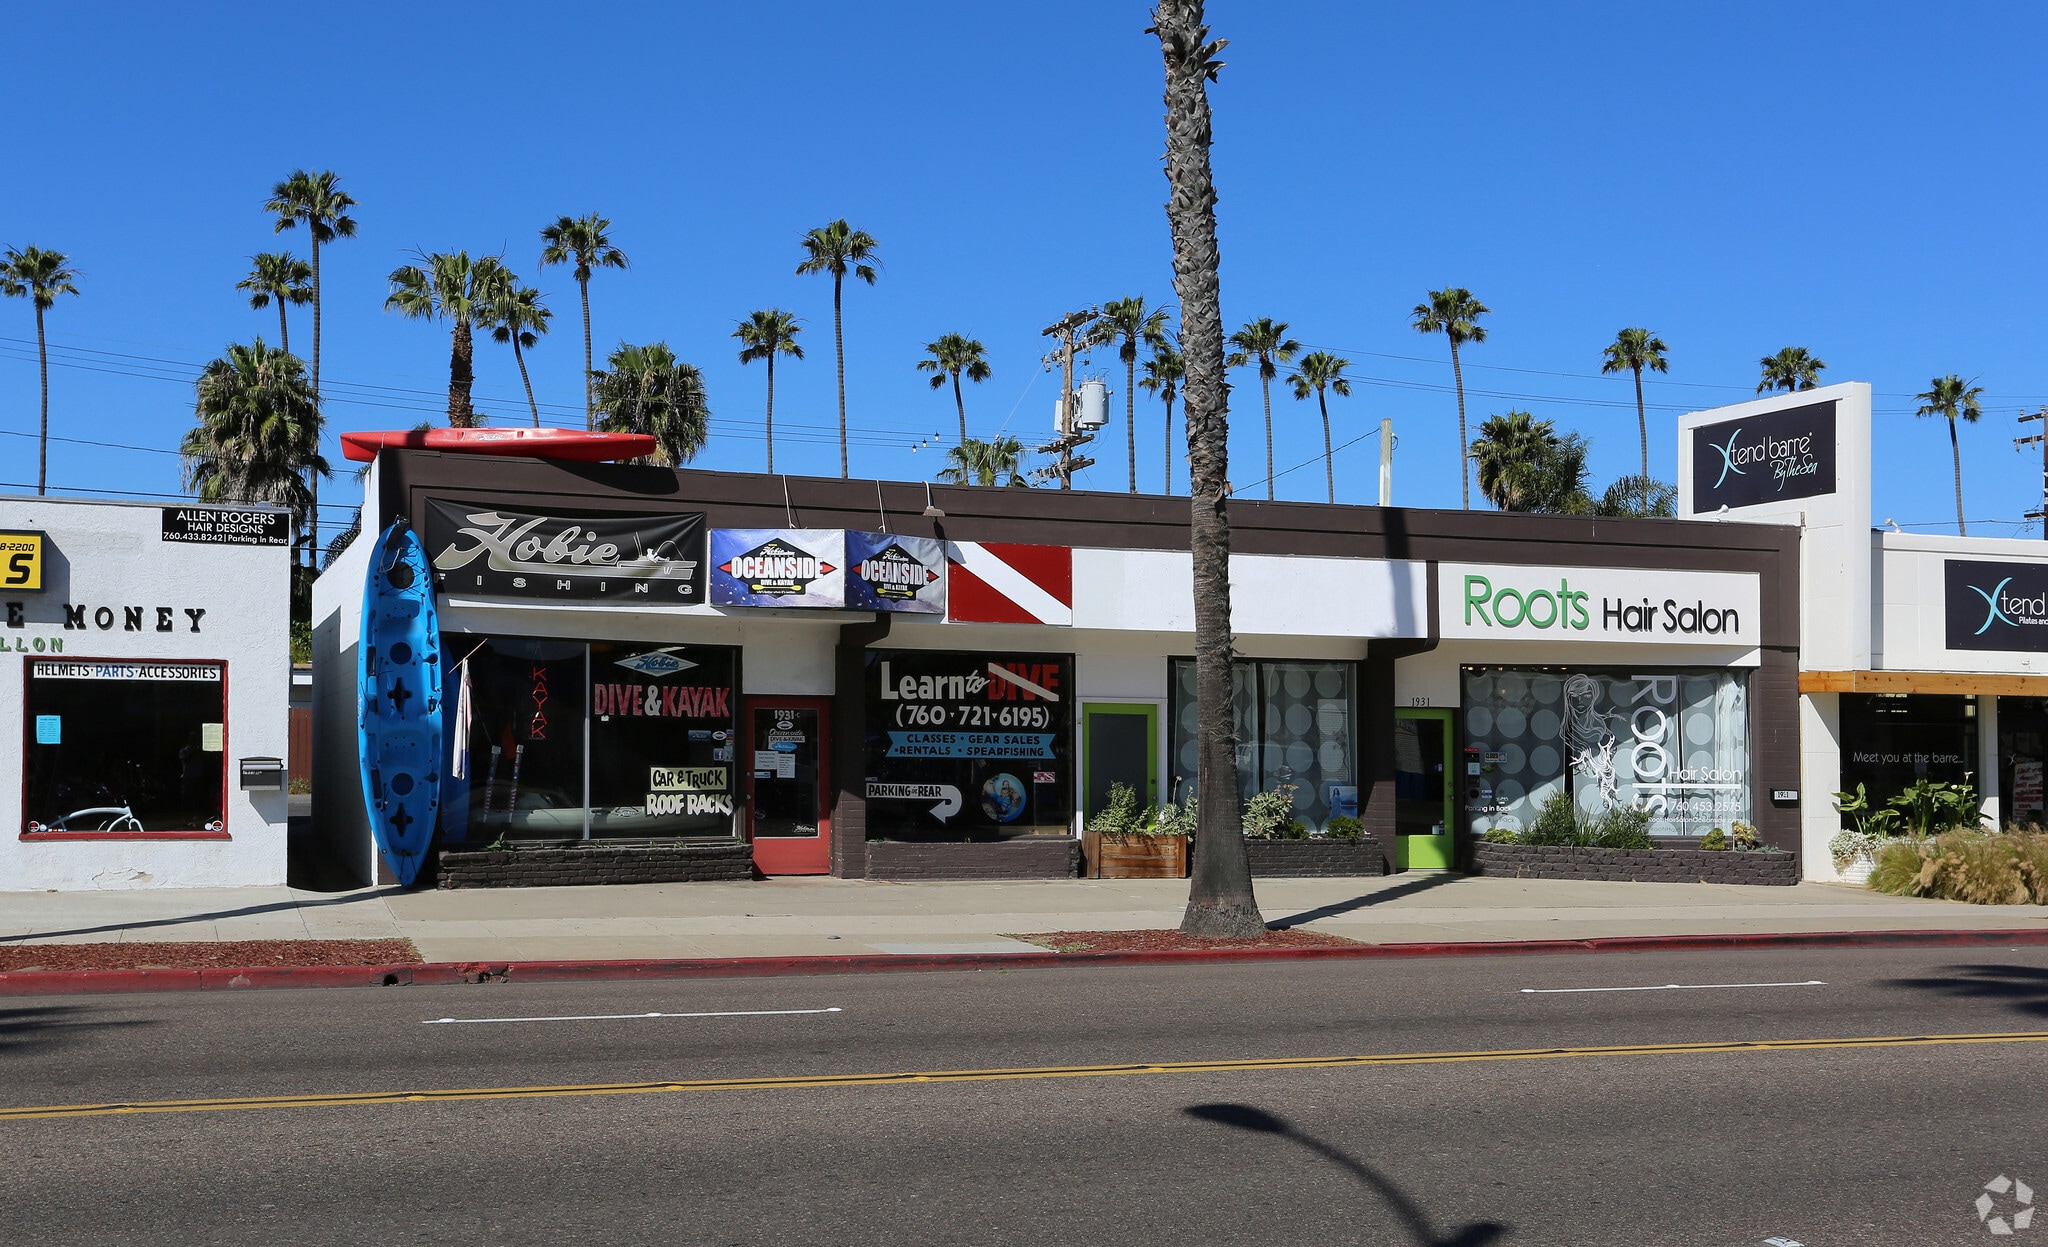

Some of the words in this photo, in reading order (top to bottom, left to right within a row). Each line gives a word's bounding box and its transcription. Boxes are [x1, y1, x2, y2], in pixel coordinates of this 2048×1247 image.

[176, 510, 217, 522] ALLEN
[221, 511, 275, 525] ROGERS
[187, 522, 213, 532] HAIR
[216, 523, 264, 534] DESIGNS
[227, 534, 258, 544] Parking
[731, 556, 824, 579] OCEANSIDE
[861, 559, 929, 585] OCEANSIDE
[1464, 575, 1589, 629] Roots
[1603, 597, 1657, 632] Hair
[1662, 599, 1739, 634] Salon
[63, 603, 206, 632] MONEY
[37, 664, 90, 677] HELMETS
[95, 666, 134, 678] PARTS
[138, 667, 217, 680] ACCESSORIES
[881, 661, 965, 700] Learn
[988, 663, 1059, 702] DIVE
[532, 667, 548, 738] KAYAK
[1411, 698, 1430, 707] 1931
[906, 734, 956, 744] CLASSES
[968, 735, 1000, 744] GEAR
[1004, 736, 1040, 745] SALES
[900, 746, 951, 755] RENTALS
[967, 747, 1044, 756] SPEARFISHING
[1853, 752, 1879, 763] Meet
[1881, 753, 1900, 765] you
[1902, 753, 1912, 763] at
[1914, 752, 1929, 763] the
[652, 770, 674, 787] CAR
[687, 771, 724, 788] TRUCK
[1669, 766, 1697, 780] Hair
[1700, 766, 1741, 780] Salon
[868, 784, 911, 797] PARKING
[917, 786, 942, 797] REAR
[646, 793, 684, 816] ROOF
[687, 794, 734, 816] RACKS
